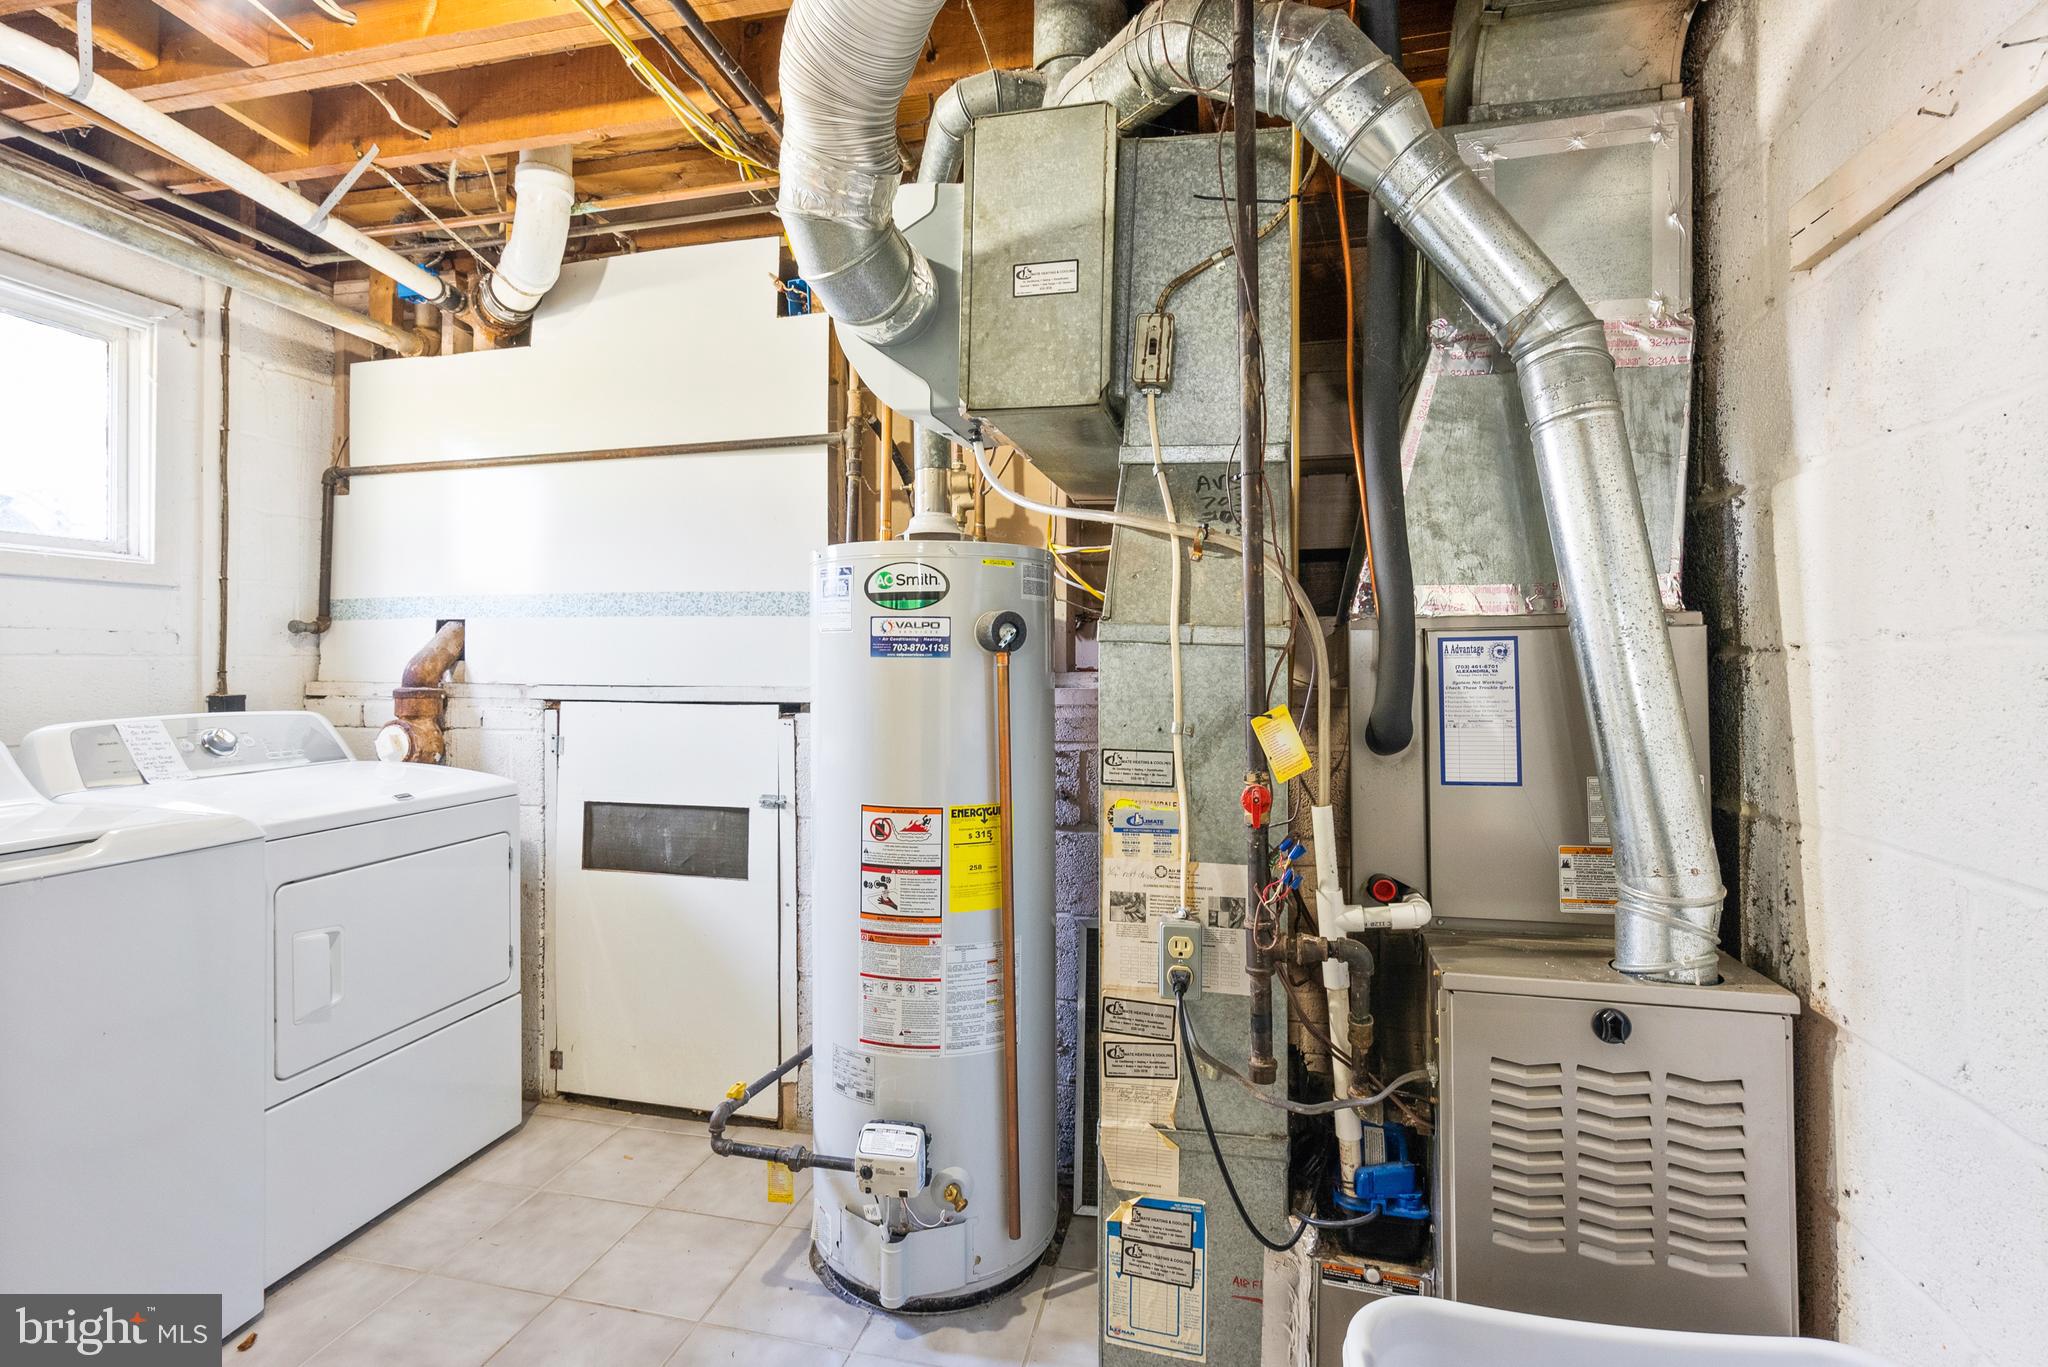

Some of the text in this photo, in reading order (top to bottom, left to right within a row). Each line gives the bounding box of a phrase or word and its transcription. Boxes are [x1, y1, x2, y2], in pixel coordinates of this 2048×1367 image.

[1650, 338, 1677, 347] 324A
[1648, 356, 1676, 366] 324A
[896, 573, 938, 586] Smith
[895, 621, 941, 629] VALPO
[892, 643, 949, 652] 703-870-1135
[1444, 643, 1484, 656] A Advantage
[975, 830, 992, 839] 315
[1233, 1275, 1250, 1288] AIR
